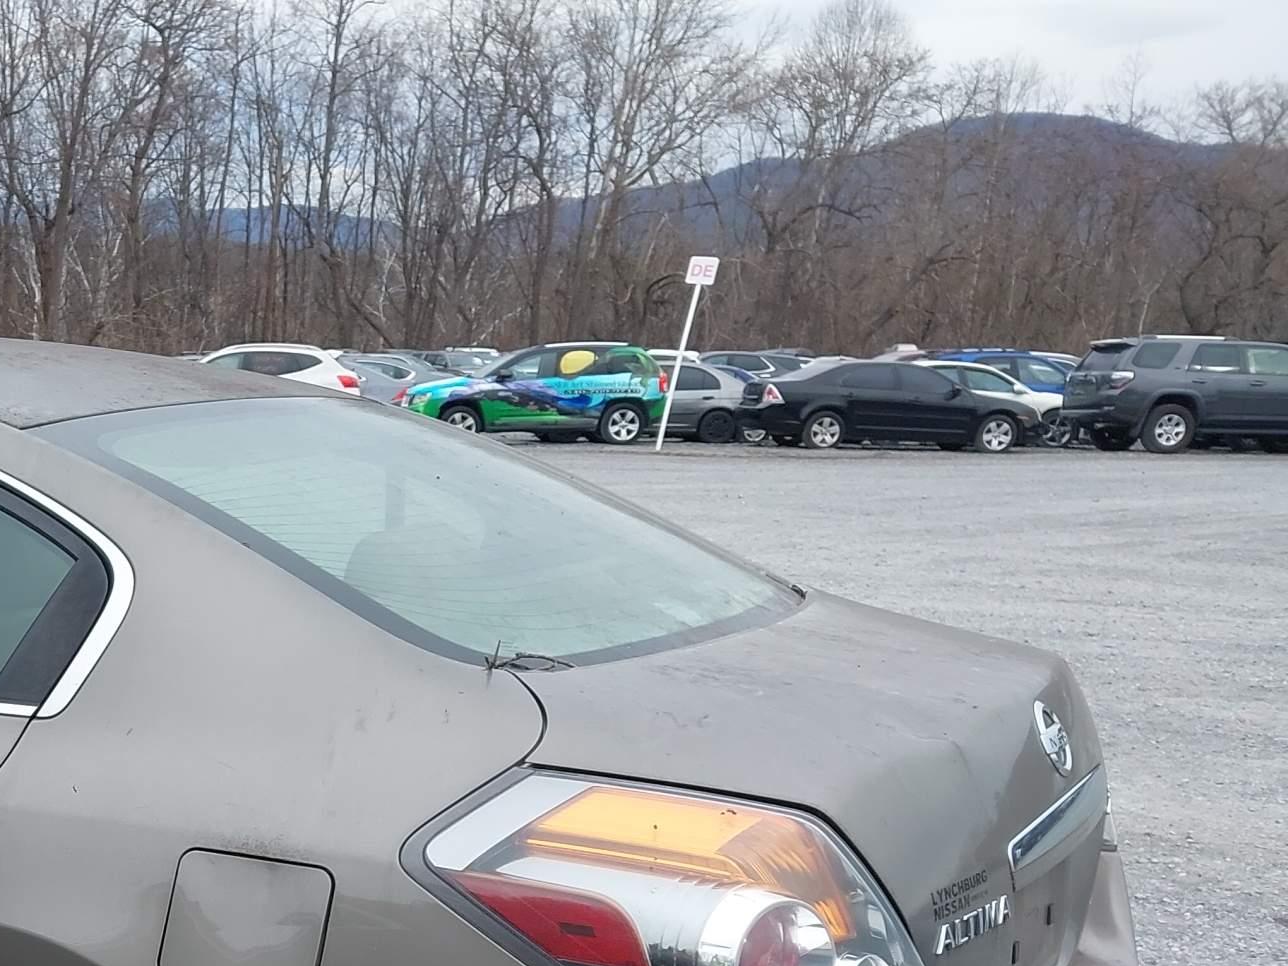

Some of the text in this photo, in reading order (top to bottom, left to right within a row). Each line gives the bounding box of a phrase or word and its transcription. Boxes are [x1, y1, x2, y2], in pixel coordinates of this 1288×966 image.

[691, 263, 714, 278] DE
[931, 870, 988, 906] LYNCHBURG
[934, 894, 971, 921] NISSAN
[934, 894, 1011, 955] ALTIMA
